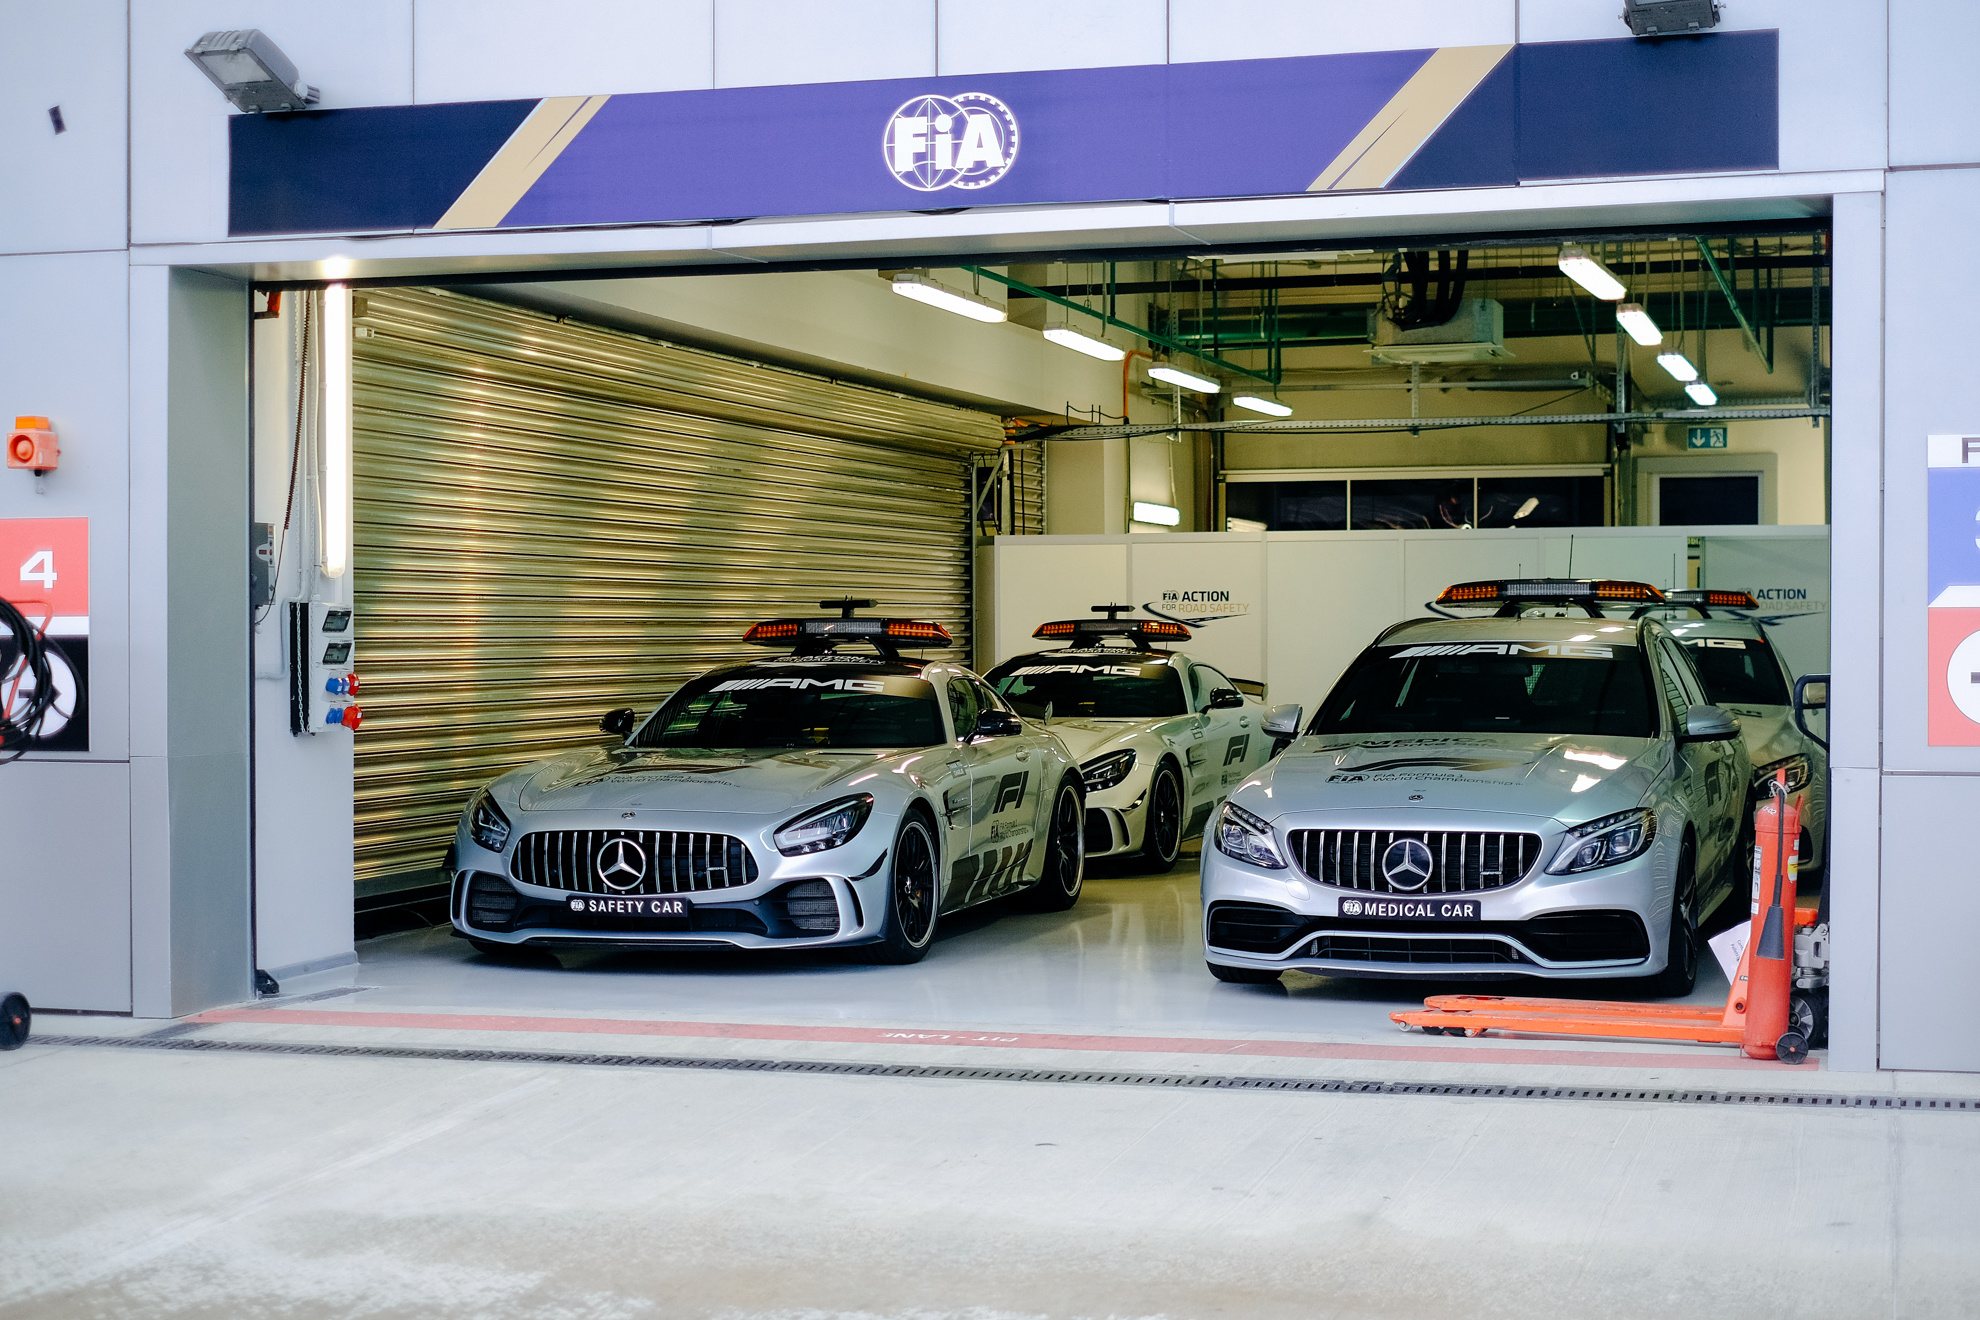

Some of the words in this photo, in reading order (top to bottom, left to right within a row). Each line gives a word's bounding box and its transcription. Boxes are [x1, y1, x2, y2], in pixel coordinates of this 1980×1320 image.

[20, 550, 58, 589] 4
[1182, 590, 1230, 602] ACTION
[1756, 588, 1807, 600] ACTION
[1161, 603, 1177, 611] FOR
[1178, 603, 1207, 613] ROAD
[1209, 603, 1249, 613] SAFETY
[1760, 601, 1783, 611] OAD
[1785, 601, 1827, 611] SAFETY
[1457, 644, 1613, 659] AMG
[1045, 664, 1141, 676] AMG
[757, 678, 884, 692] AMG
[1327, 774, 1366, 783] FIA
[589, 900, 644, 913] SAFETY
[651, 901, 683, 914] CAR
[1364, 902, 1436, 917] MEDICAL
[1441, 904, 1474, 917] CAR
